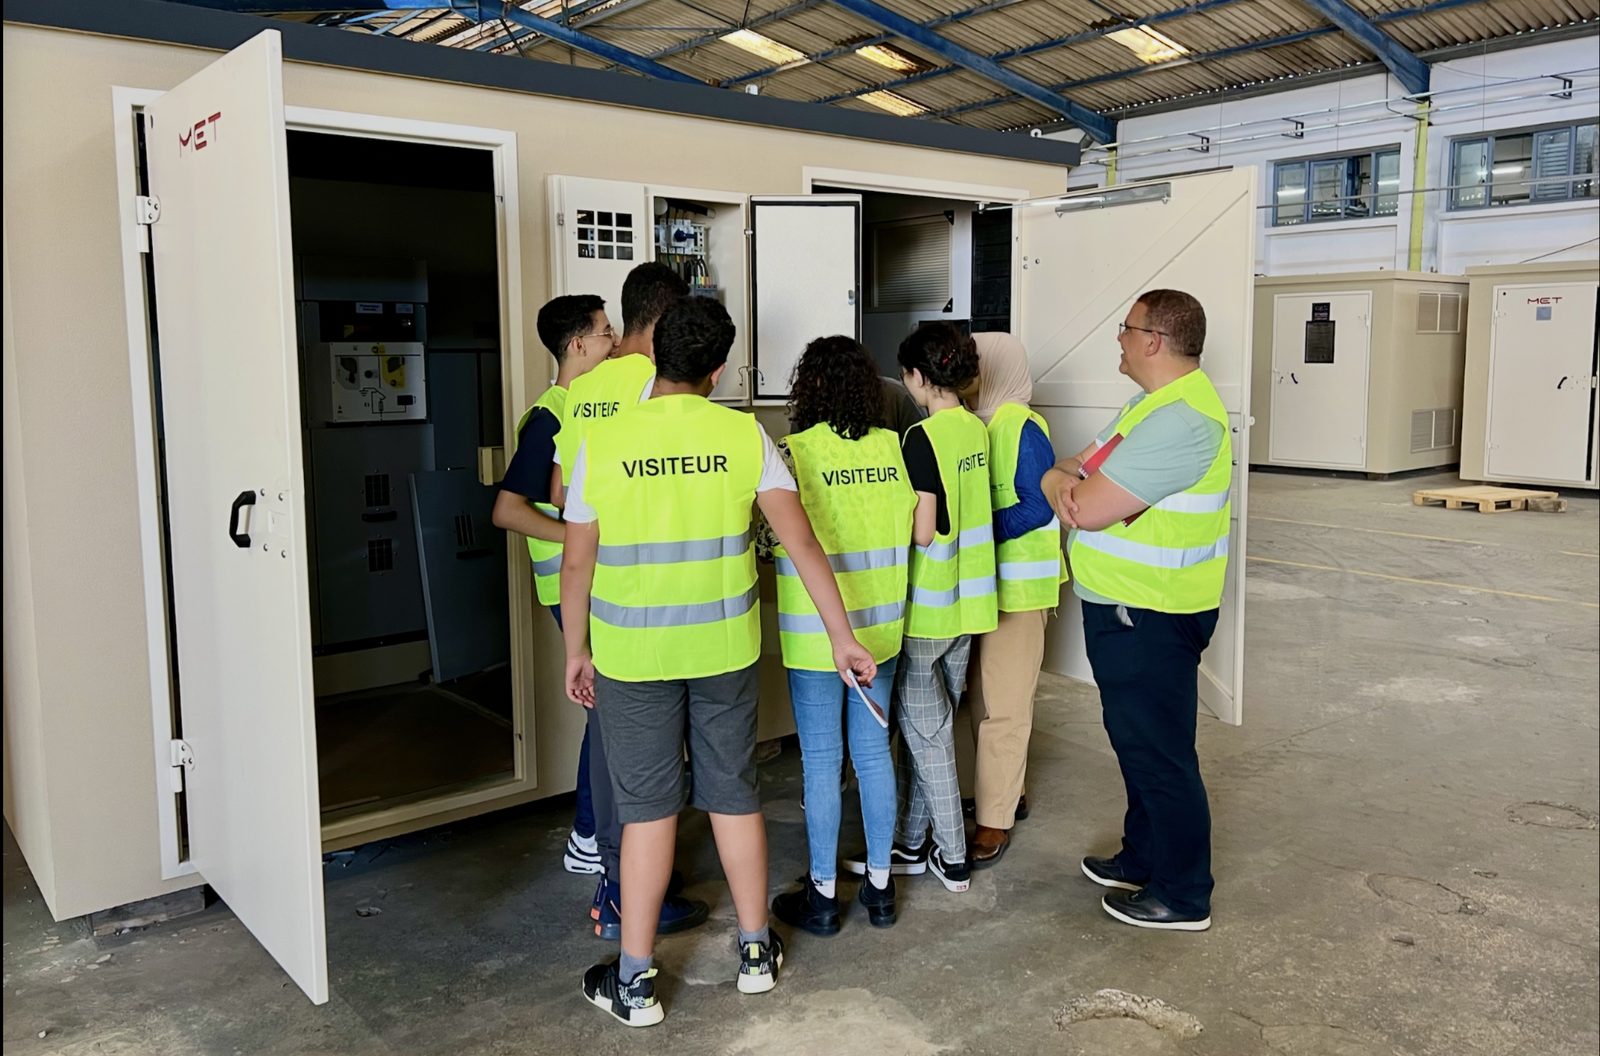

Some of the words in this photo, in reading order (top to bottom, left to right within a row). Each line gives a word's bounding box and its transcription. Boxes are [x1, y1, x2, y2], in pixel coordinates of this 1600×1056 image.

[178, 111, 221, 158] MET
[1527, 296, 1562, 304] MET
[622, 455, 728, 478] VISITEUR
[957, 452, 987, 473] VISITE
[822, 467, 899, 486] VISITEUR
